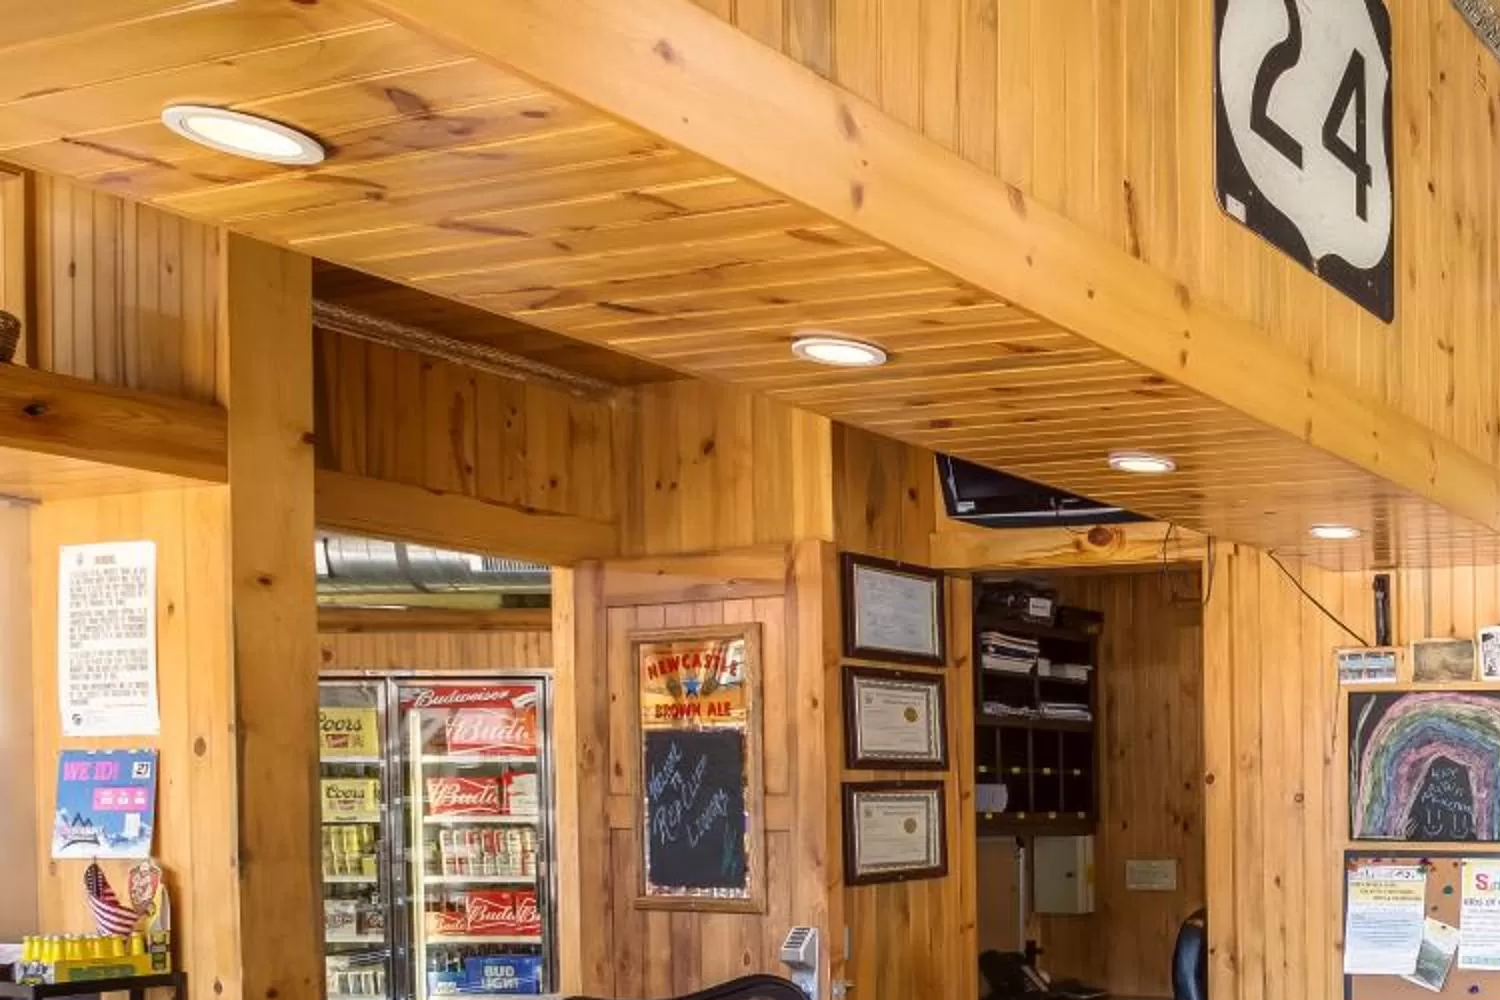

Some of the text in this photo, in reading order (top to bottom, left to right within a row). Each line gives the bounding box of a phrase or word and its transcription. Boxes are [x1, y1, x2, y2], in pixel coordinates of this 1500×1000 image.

[1250, 0, 1372, 222] 24
[648, 647, 738, 680] NEWCASTLE
[415, 687, 511, 707] Budweiser
[655, 701, 731, 719] BROWN ALE
[483, 965, 515, 977] BUD
